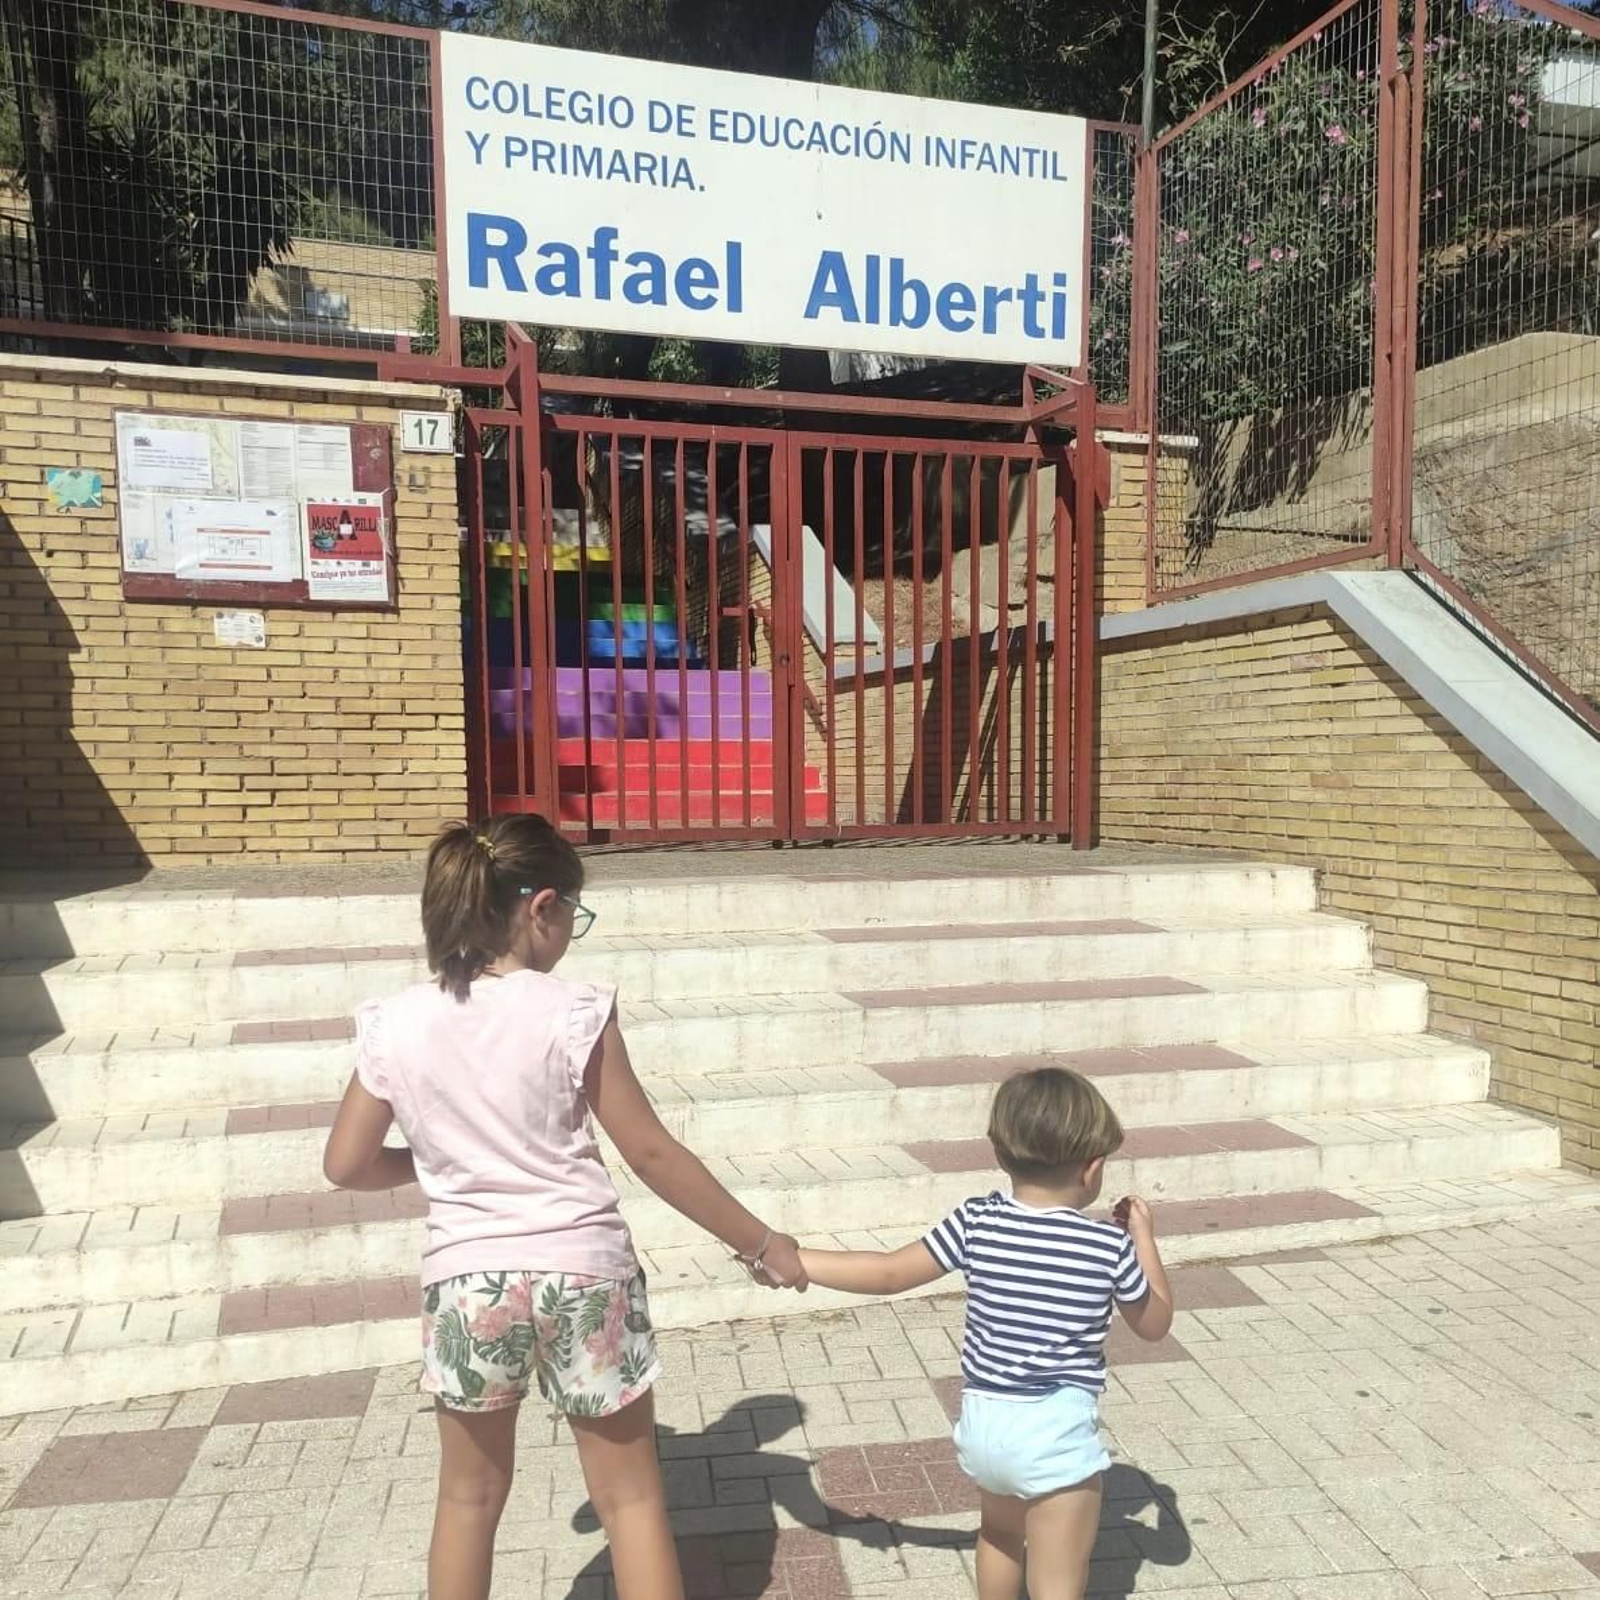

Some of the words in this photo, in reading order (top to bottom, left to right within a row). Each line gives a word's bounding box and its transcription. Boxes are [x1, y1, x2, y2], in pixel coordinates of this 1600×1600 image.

[464, 130, 489, 165] Y
[504, 136, 706, 192] PRIMARIA.
[465, 75, 633, 130] COLEGIO
[647, 101, 697, 138] DE
[708, 109, 912, 165] EDUCACIÓN
[924, 137, 1068, 182] INFANTIL
[465, 211, 744, 314] Rafael
[803, 249, 1068, 340] Alberti
[413, 418, 439, 446] 17
